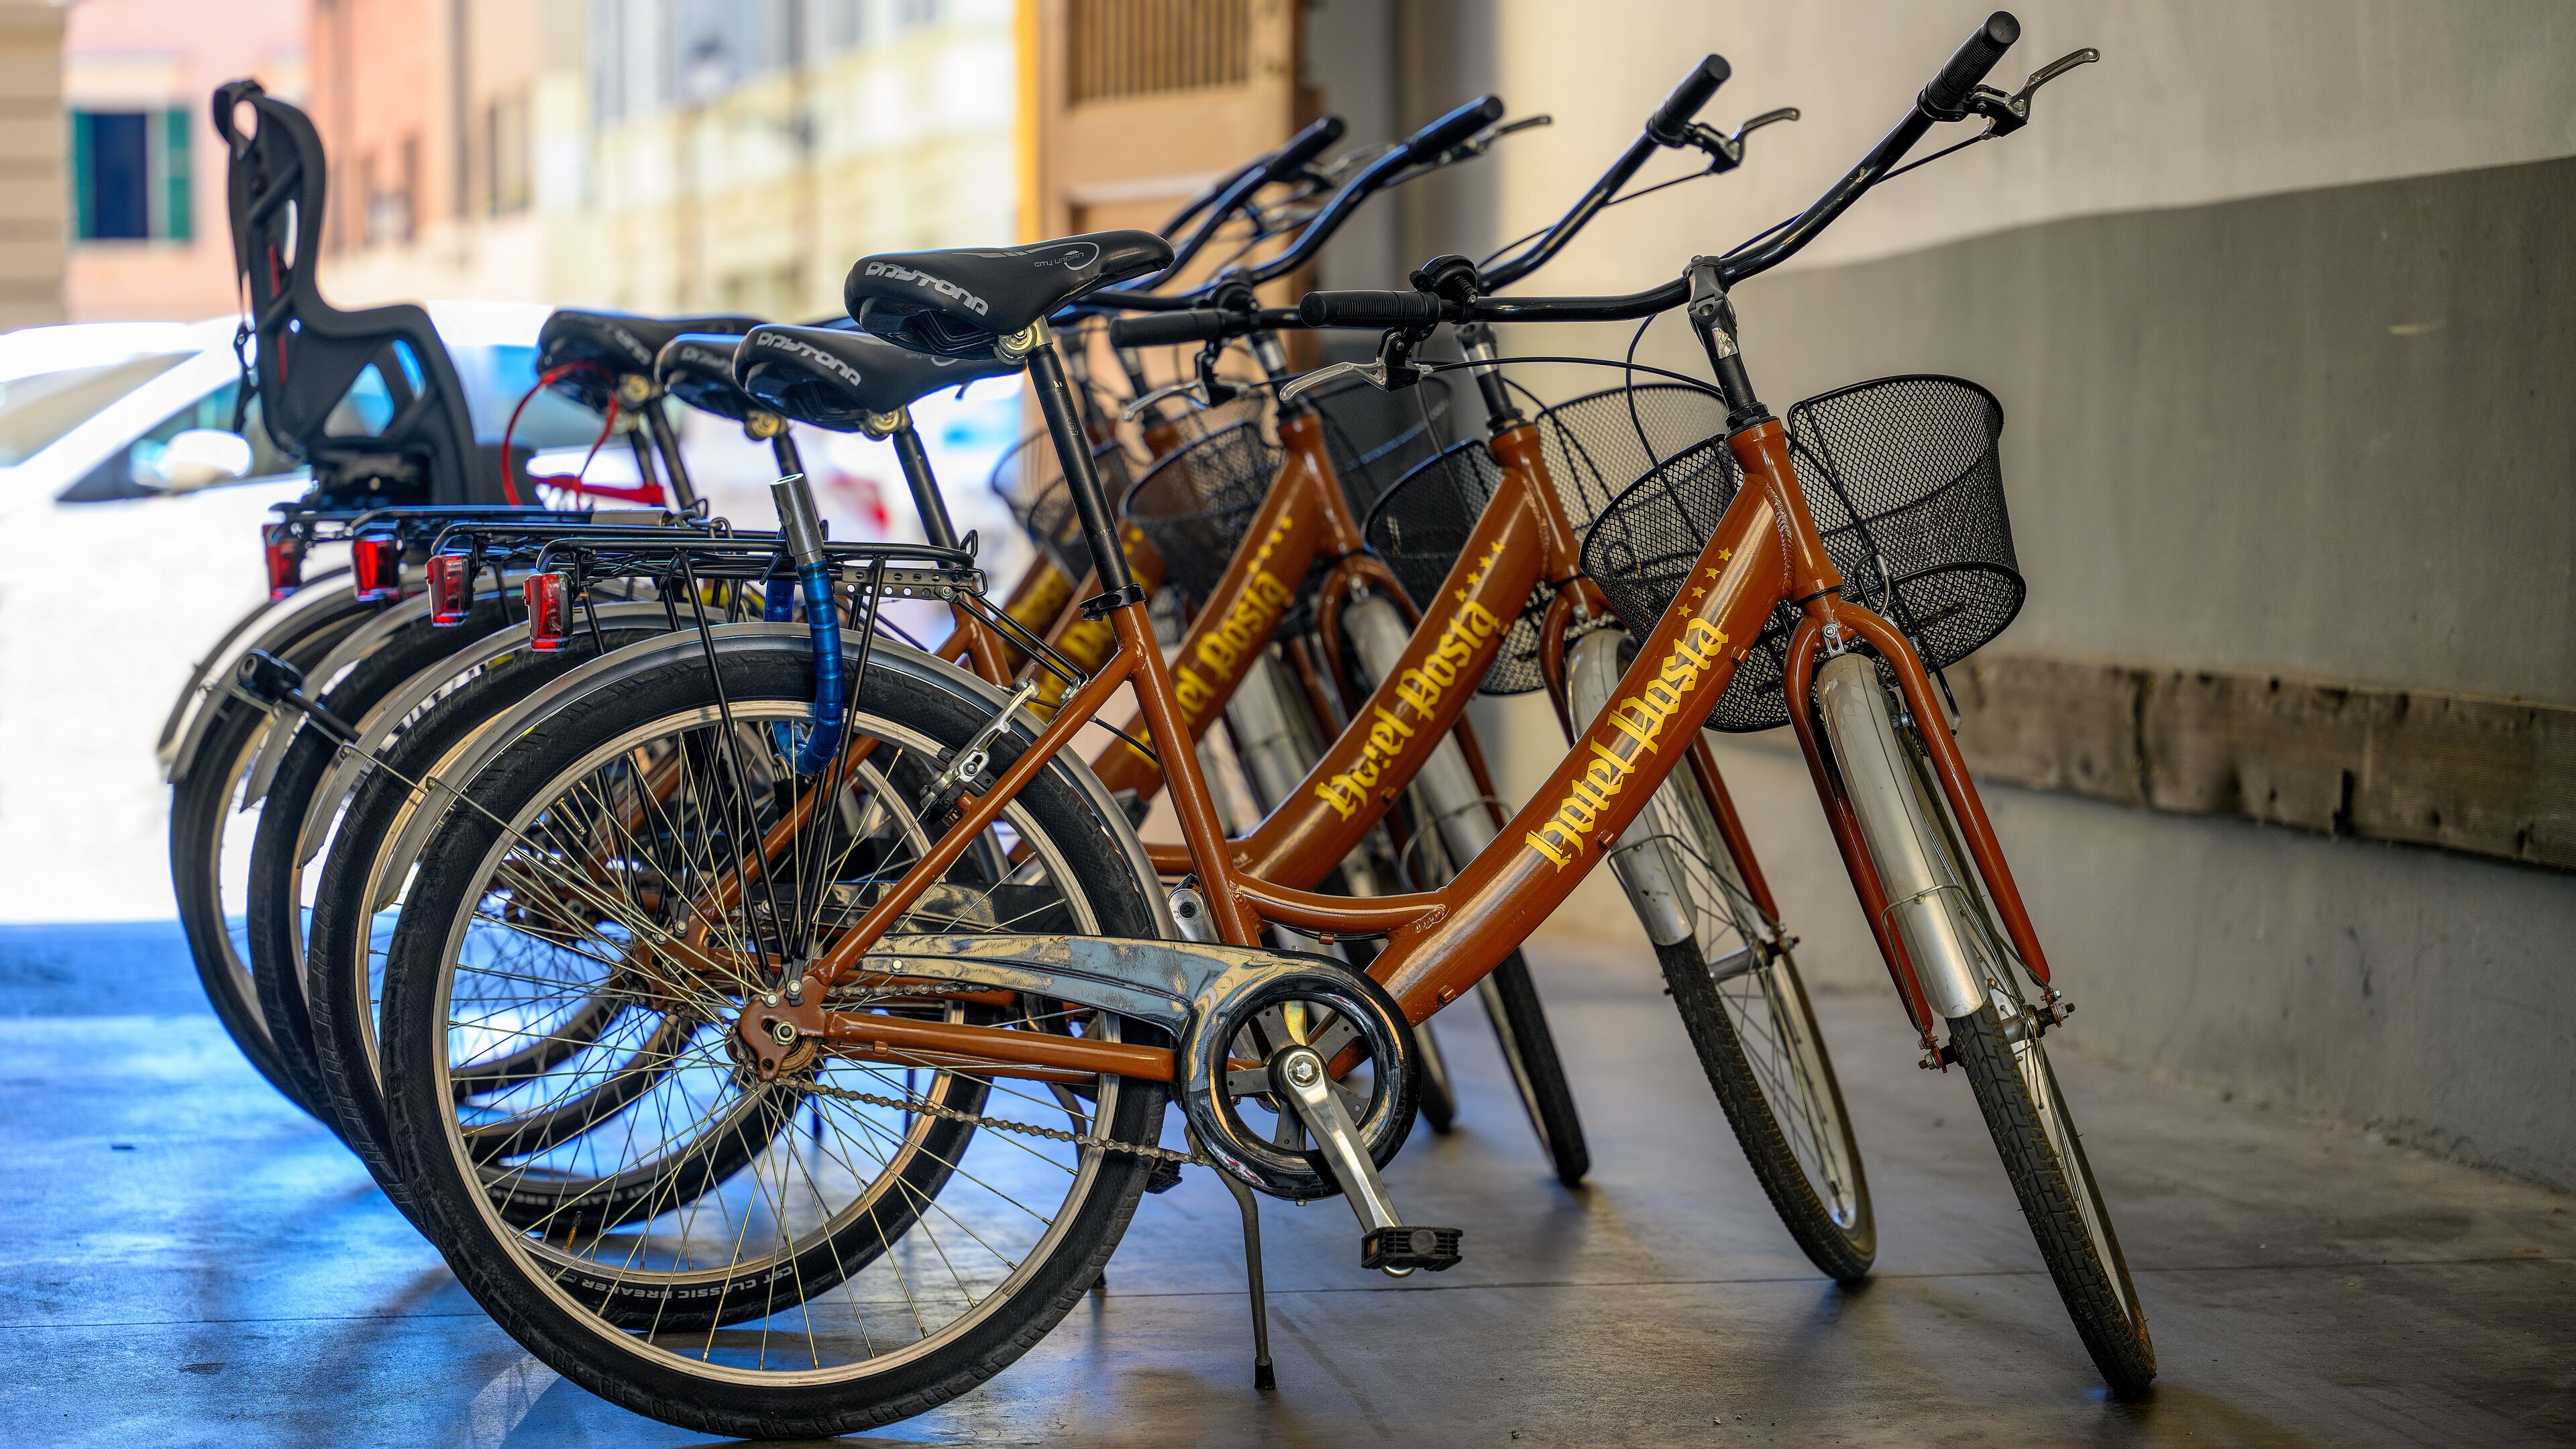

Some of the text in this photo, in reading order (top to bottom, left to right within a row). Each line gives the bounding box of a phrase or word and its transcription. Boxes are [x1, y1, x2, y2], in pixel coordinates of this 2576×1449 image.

[865, 261, 989, 317] DAYTONA
[756, 331, 862, 386] DAYTONA
[1395, 600, 1500, 720] Posta
[1607, 616, 1729, 755] Posta
[582, 1265, 794, 1299] CST CLASSIC BREAKER
